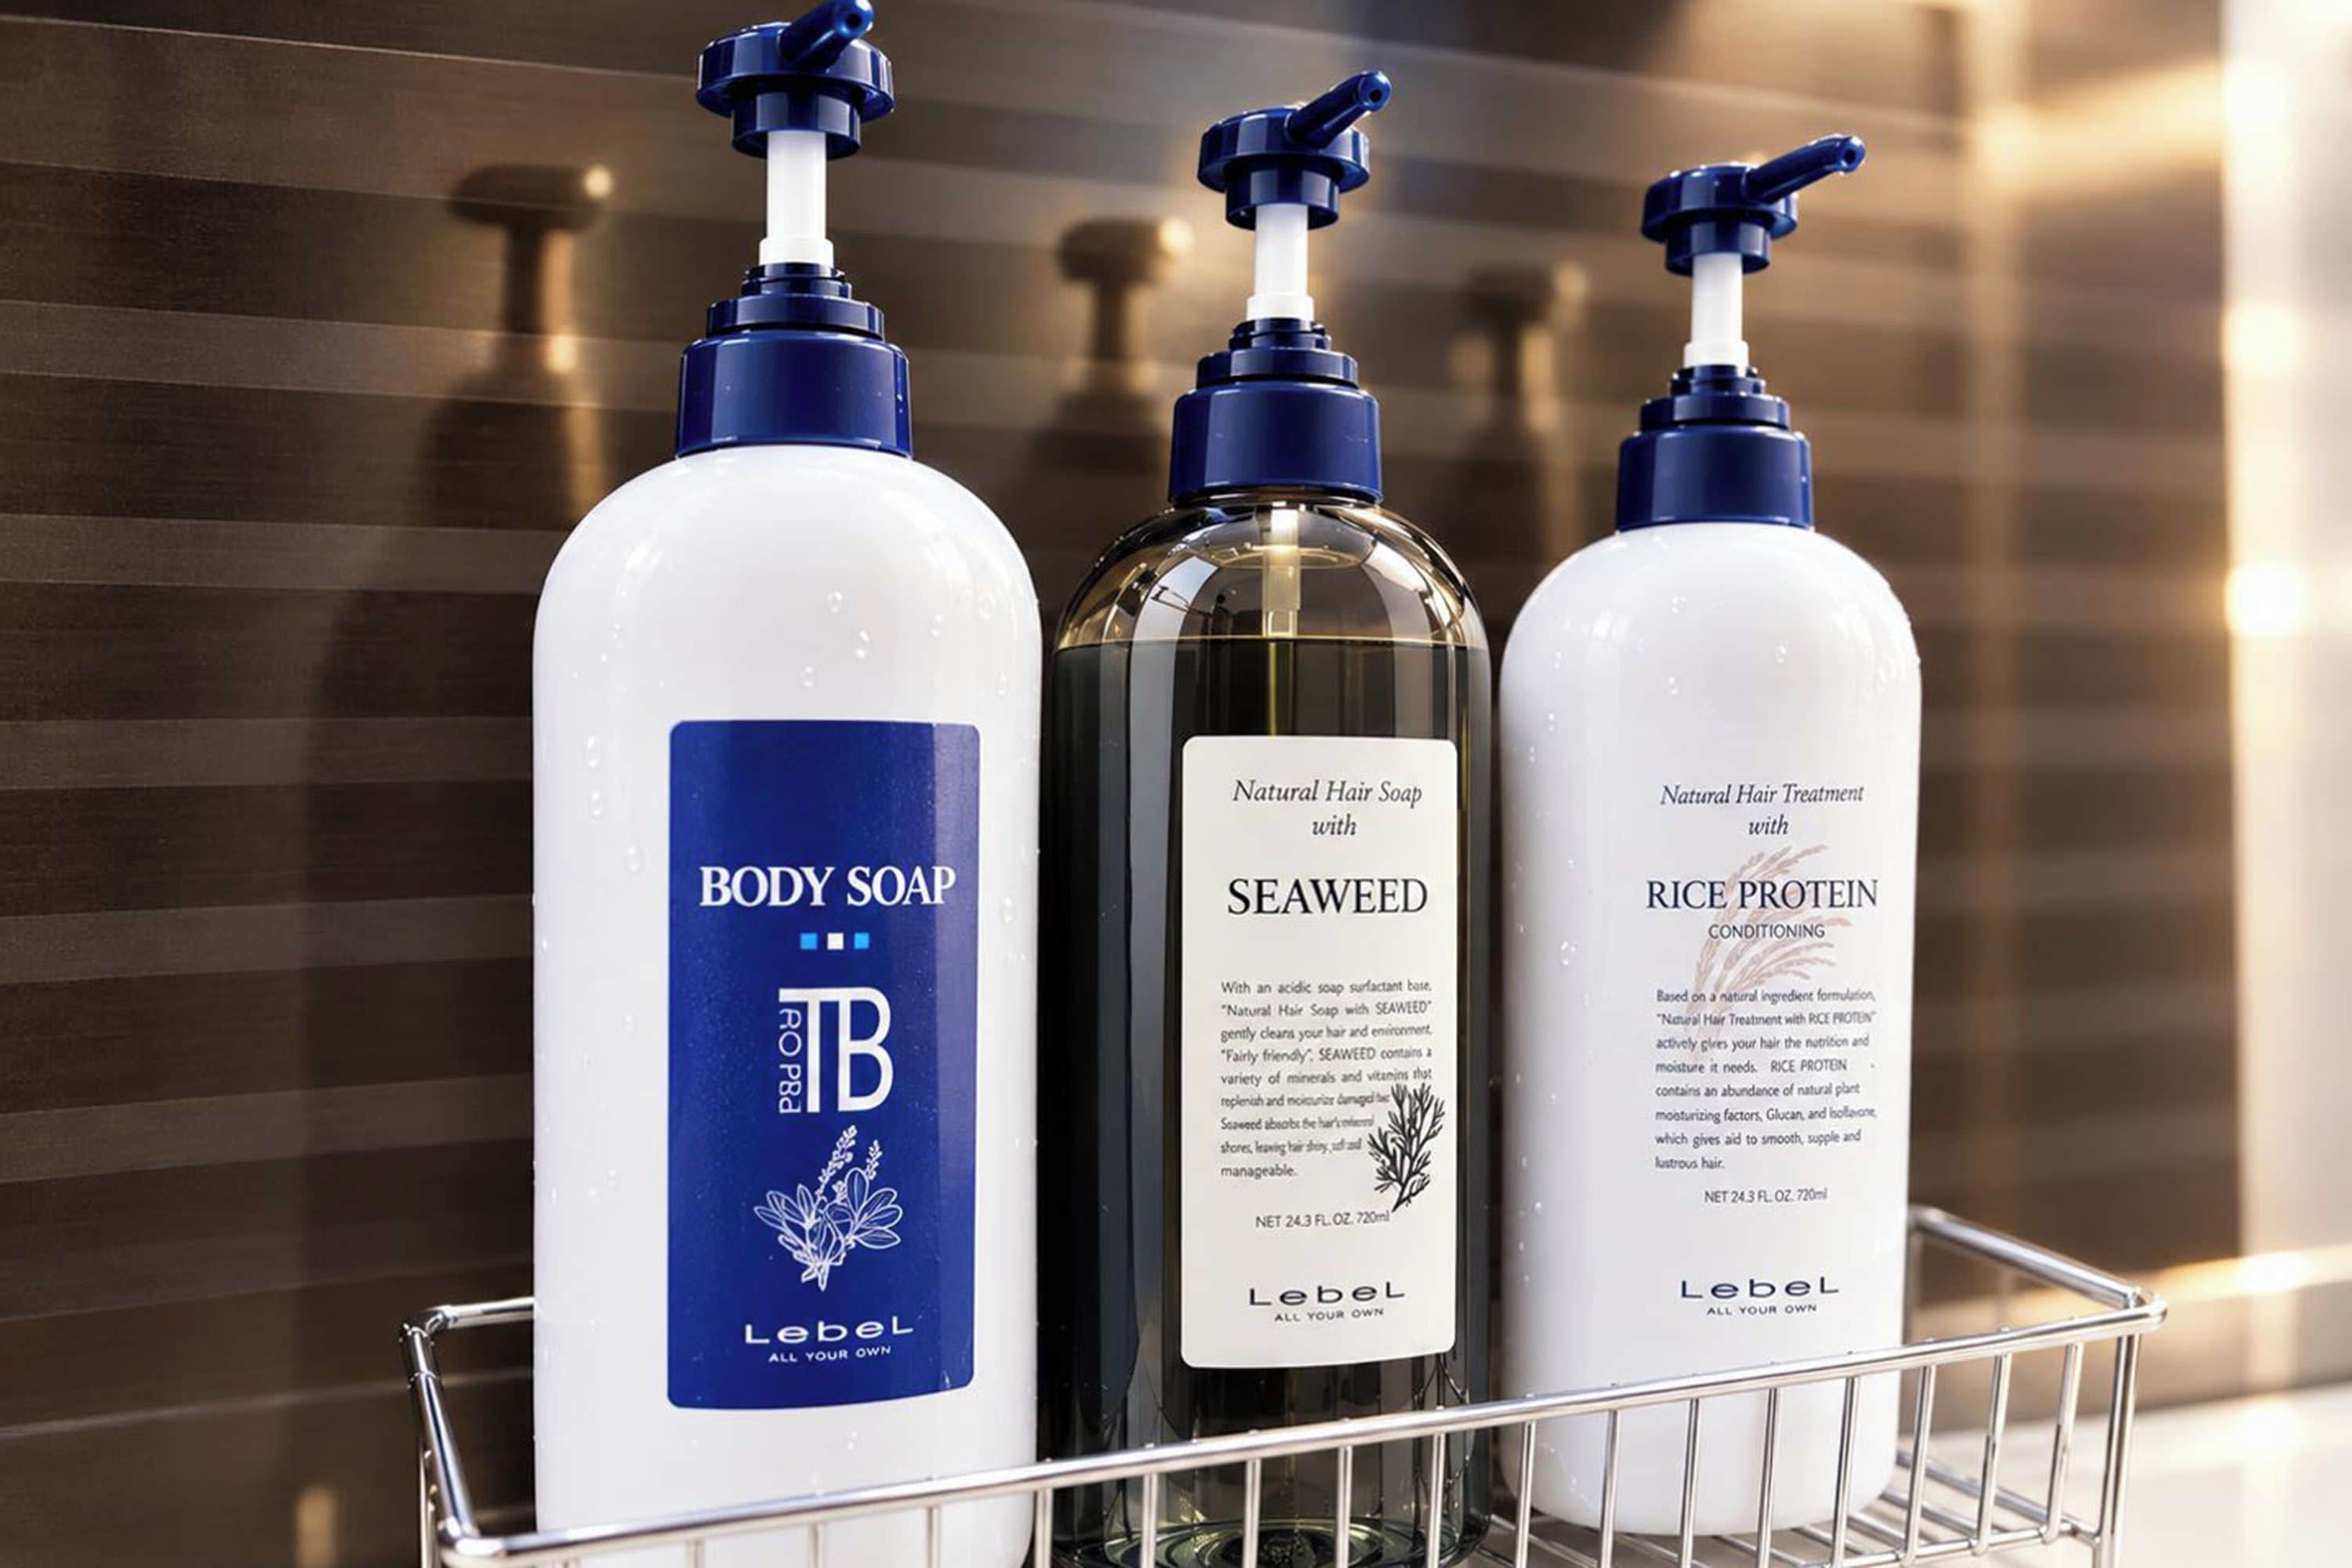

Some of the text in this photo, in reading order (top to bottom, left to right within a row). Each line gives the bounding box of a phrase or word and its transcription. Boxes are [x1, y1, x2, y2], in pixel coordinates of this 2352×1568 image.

[1233, 779, 1422, 809] Natural Hair Soap
[1661, 783, 1864, 804] Natural Hair Treatment
[1312, 813, 1356, 836] with
[1749, 814, 1788, 835] with
[699, 864, 956, 907] BODY SOAP
[1228, 878, 1427, 915] SEAWEED
[1647, 880, 1877, 909] RICE PROTEIN
[1708, 924, 1824, 941] CONDITIONING
[1221, 982, 1250, 993] With
[1257, 984, 1272, 993] an
[1278, 981, 1311, 994] acidic
[1318, 984, 1345, 996] soap
[1349, 979, 1403, 993] surfactant
[1657, 989, 1688, 1002] Based
[1691, 993, 1706, 1004] on
[1710, 993, 1716, 1002] a
[1720, 989, 1758, 1003] natural
[1762, 989, 1813, 1005] ingredient
[1278, 1004, 1303, 1016] Hair
[1310, 1004, 1339, 1018] Soap
[1345, 1004, 1369, 1014] with
[1704, 1011, 1726, 1025] Hair
[1729, 1013, 1782, 1025] Treatment
[1784, 1013, 1806, 1025] with
[1809, 1012, 1830, 1025] RICE
[1221, 1026, 1257, 1043] gently
[1260, 1026, 1295, 1039] cleans
[1298, 1029, 1323, 1042] your
[1349, 1025, 1368, 1037] and
[1656, 1036, 1697, 1052] actively
[1732, 1040, 1756, 1052] your
[1760, 1036, 1780, 1049] hair
[1784, 1036, 1802, 1049] the
[1806, 1036, 1849, 1048] nutrition
[1852, 1034, 1869, 1047] and
[1319, 1047, 1376, 1062] SEAWEED
[1380, 1048, 1422, 1059] contains
[1427, 1048, 1432, 1057] a
[1656, 1060, 1704, 1073] moisture
[1710, 1058, 1718, 1073] it
[1770, 1059, 1795, 1073] RICE
[1800, 1058, 1847, 1072] PROTEIN
[1221, 1072, 1262, 1087] variety
[1268, 1071, 1280, 1085] of
[1287, 1072, 1336, 1083] minerals
[1341, 1069, 1363, 1083] and
[1367, 1069, 1409, 1081] vitamins
[1656, 1082, 1860, 1098] contains an abundance of natural plant
[1265, 1094, 1284, 1106] and
[1656, 1109, 1721, 1124] moisturizing
[1808, 1107, 1827, 1120] and
[1656, 1133, 1688, 1145] which
[1693, 1133, 1720, 1149] gives
[1725, 1133, 1741, 1145] aid
[1746, 1135, 1758, 1145] to
[1808, 1131, 1840, 1146] supple
[1843, 1129, 1861, 1142] and
[1655, 1156, 1725, 1169] lustrous hair.
[1221, 1163, 1297, 1180] manageable.
[1704, 1190, 1728, 1203] NET
[1731, 1190, 1755, 1203] 24.3
[1797, 1188, 1828, 1201] 720ml
[1256, 1215, 1281, 1229] NET
[1286, 1214, 1312, 1228] 24.3
[1357, 1210, 1389, 1224] 720ml
[1250, 1282, 1405, 1306] LebeL
[1682, 1276, 1838, 1299] LebeL
[1275, 1308, 1383, 1322] ALL YOUR OWN
[1707, 1305, 1817, 1316] ALL YOUR OWN
[746, 1316, 913, 1344] LebeL
[768, 1346, 891, 1362] ALL YOUR OWN
